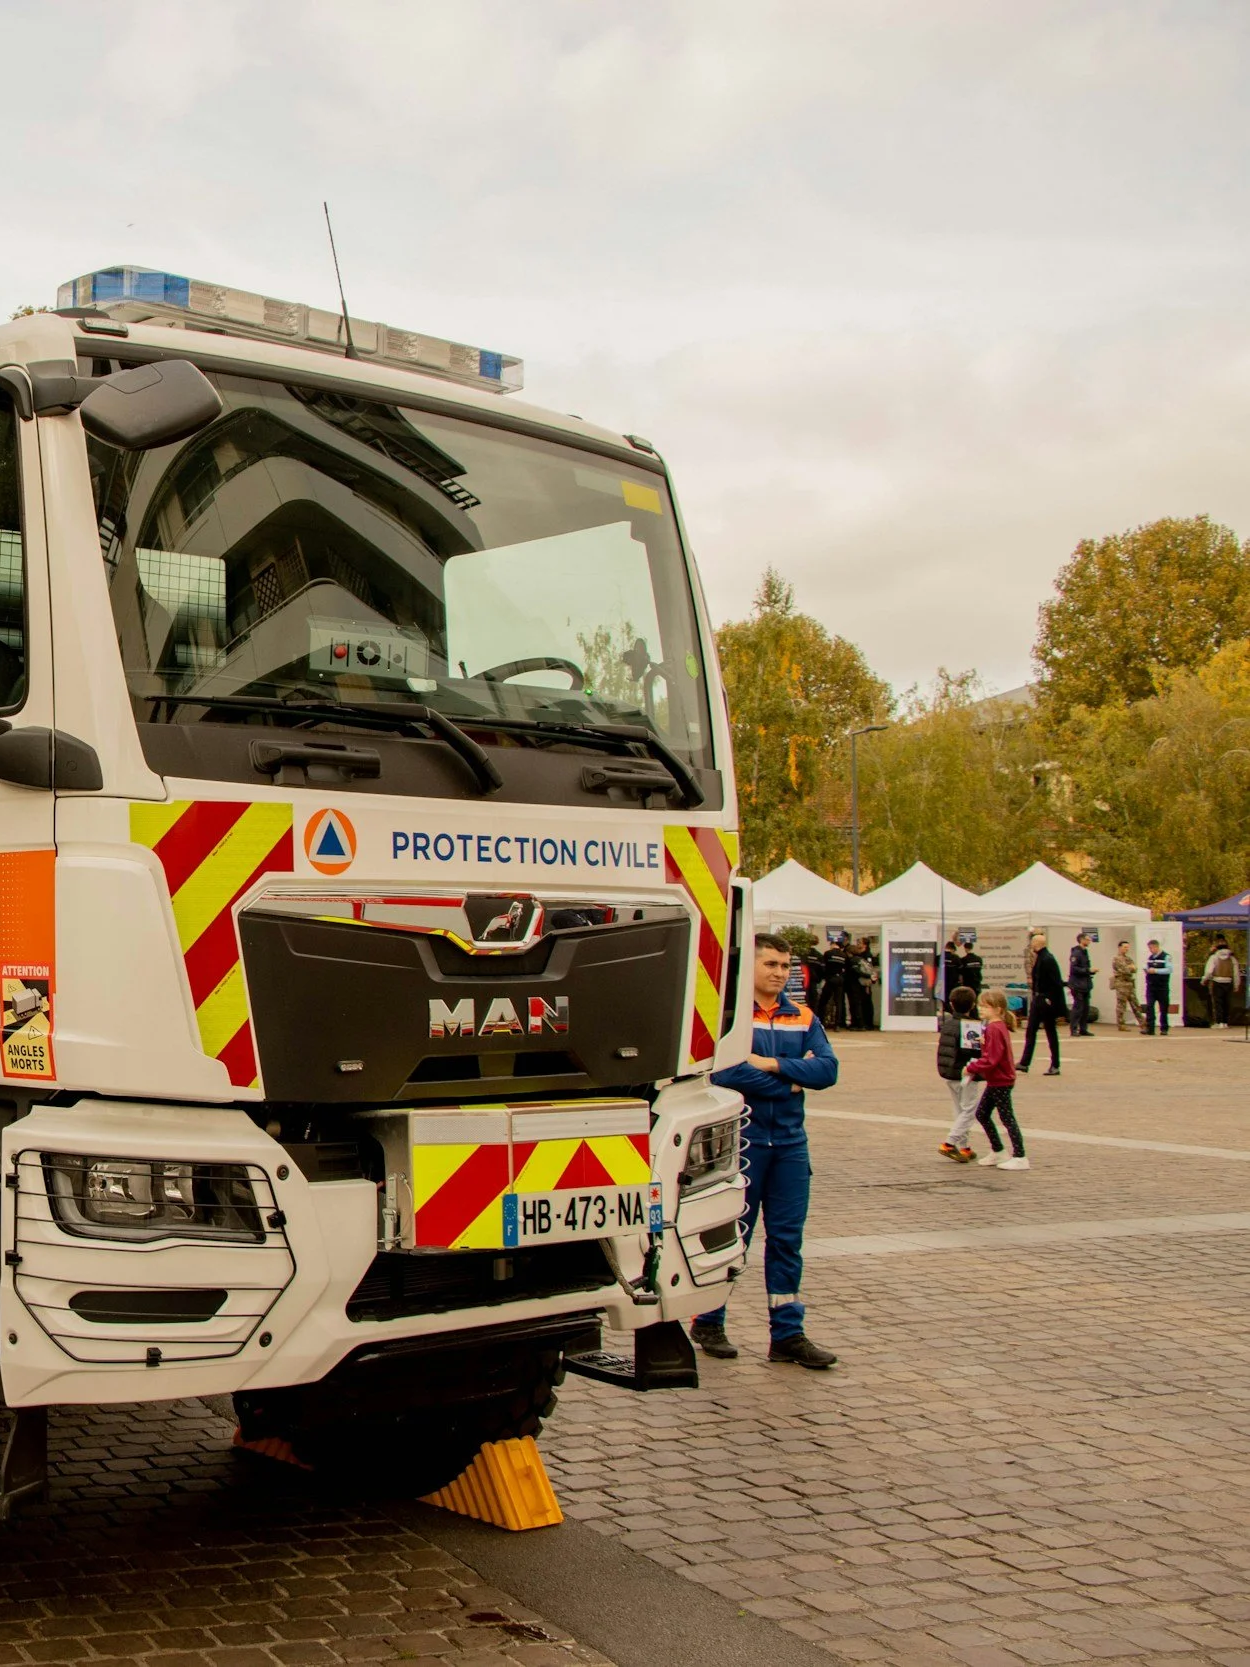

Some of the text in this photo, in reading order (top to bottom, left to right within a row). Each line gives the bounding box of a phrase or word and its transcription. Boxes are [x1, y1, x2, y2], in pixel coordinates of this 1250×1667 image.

[391, 831, 659, 869] PROTECTION CIVILE
[1, 965, 50, 977] ATTENTION
[427, 995, 570, 1039] MAN
[7, 1044, 45, 1058] ANGLES
[10, 1057, 45, 1071] MORTS
[522, 1191, 645, 1236] HB-473-NA
[650, 1209, 662, 1226] 93
[507, 1224, 514, 1237] F
